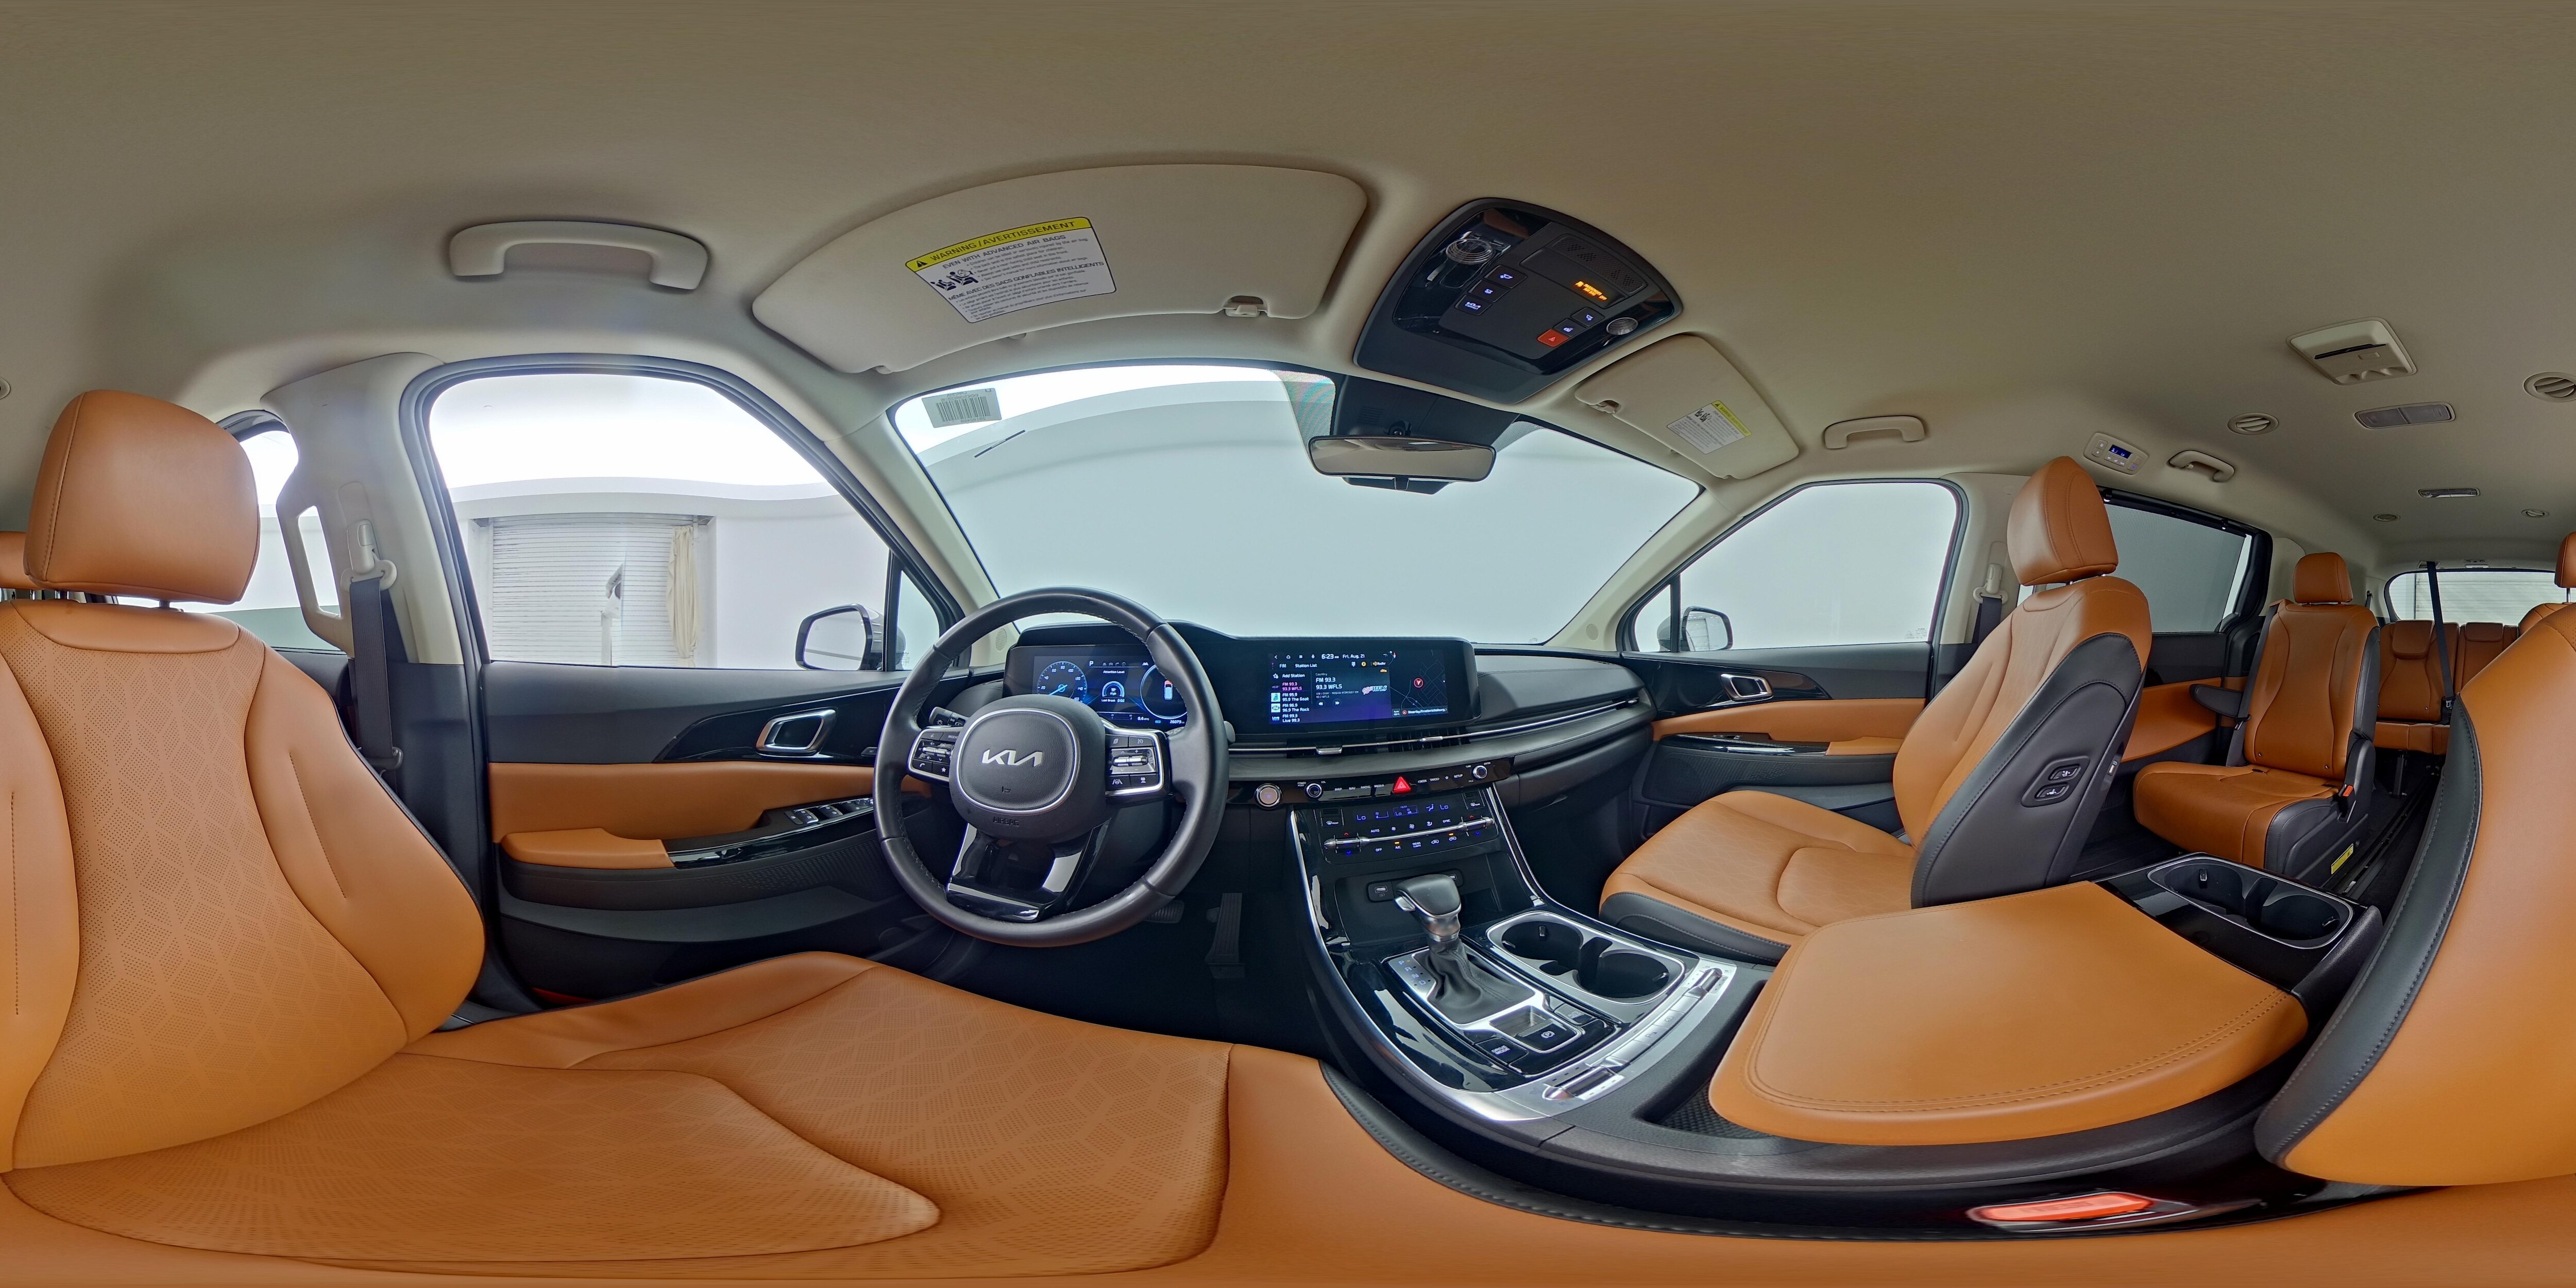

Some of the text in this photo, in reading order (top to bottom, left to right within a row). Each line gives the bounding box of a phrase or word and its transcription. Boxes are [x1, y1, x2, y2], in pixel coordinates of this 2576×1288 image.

[930, 243, 977, 261] WARNING
[942, 260, 961, 269] EVEN
[983, 243, 1024, 256] ADVANCED
[1013, 269, 1056, 281] GONFLABLES
[1056, 262, 1104, 272] INTELLIGENTS
[981, 749, 1043, 767] KIA
[993, 816, 1019, 826] AIRBAG
[1491, 1045, 1506, 1053] DRIVE
